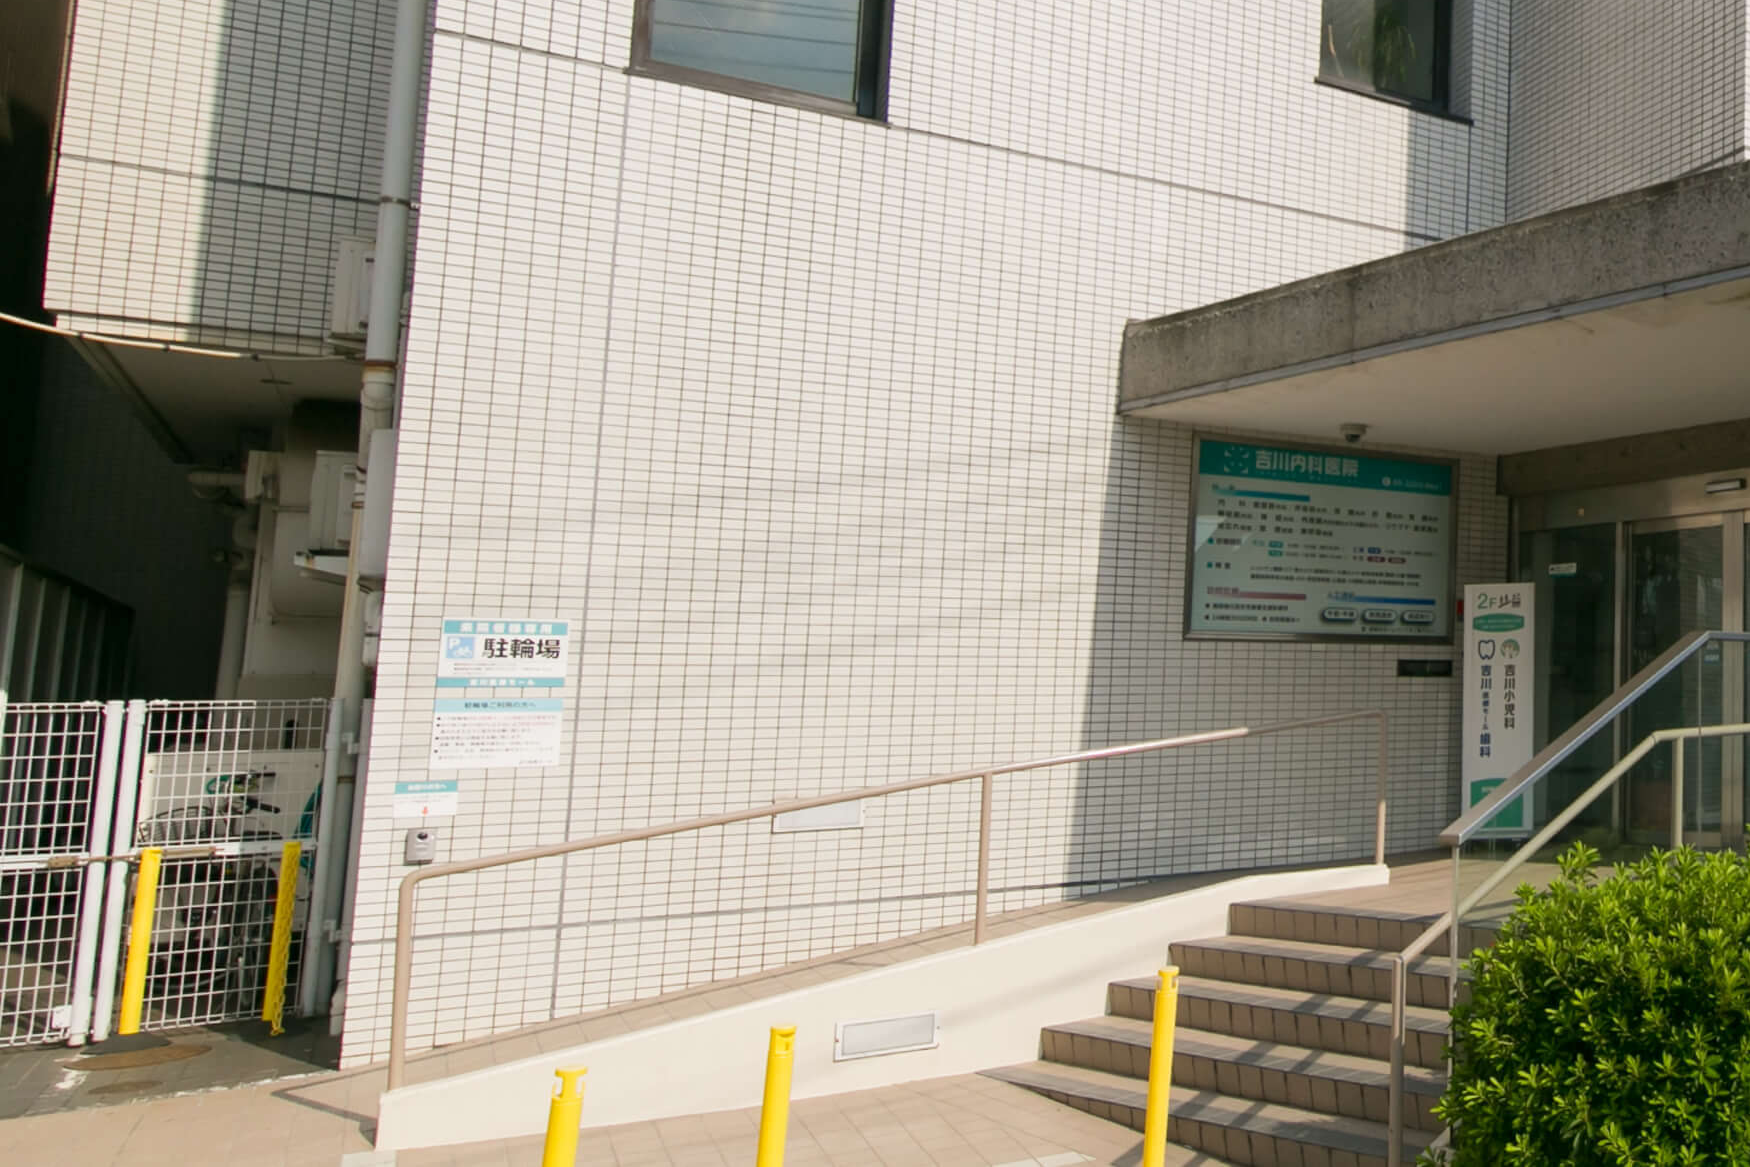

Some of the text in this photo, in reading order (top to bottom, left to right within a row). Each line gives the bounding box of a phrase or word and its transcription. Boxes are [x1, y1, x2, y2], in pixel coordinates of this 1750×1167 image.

[1255, 449, 1359, 478] 吉川内科医院
[1477, 592, 1497, 610] 2F
[482, 637, 561, 660] 駐輪場
[1503, 663, 1516, 730] 吉川小児科
